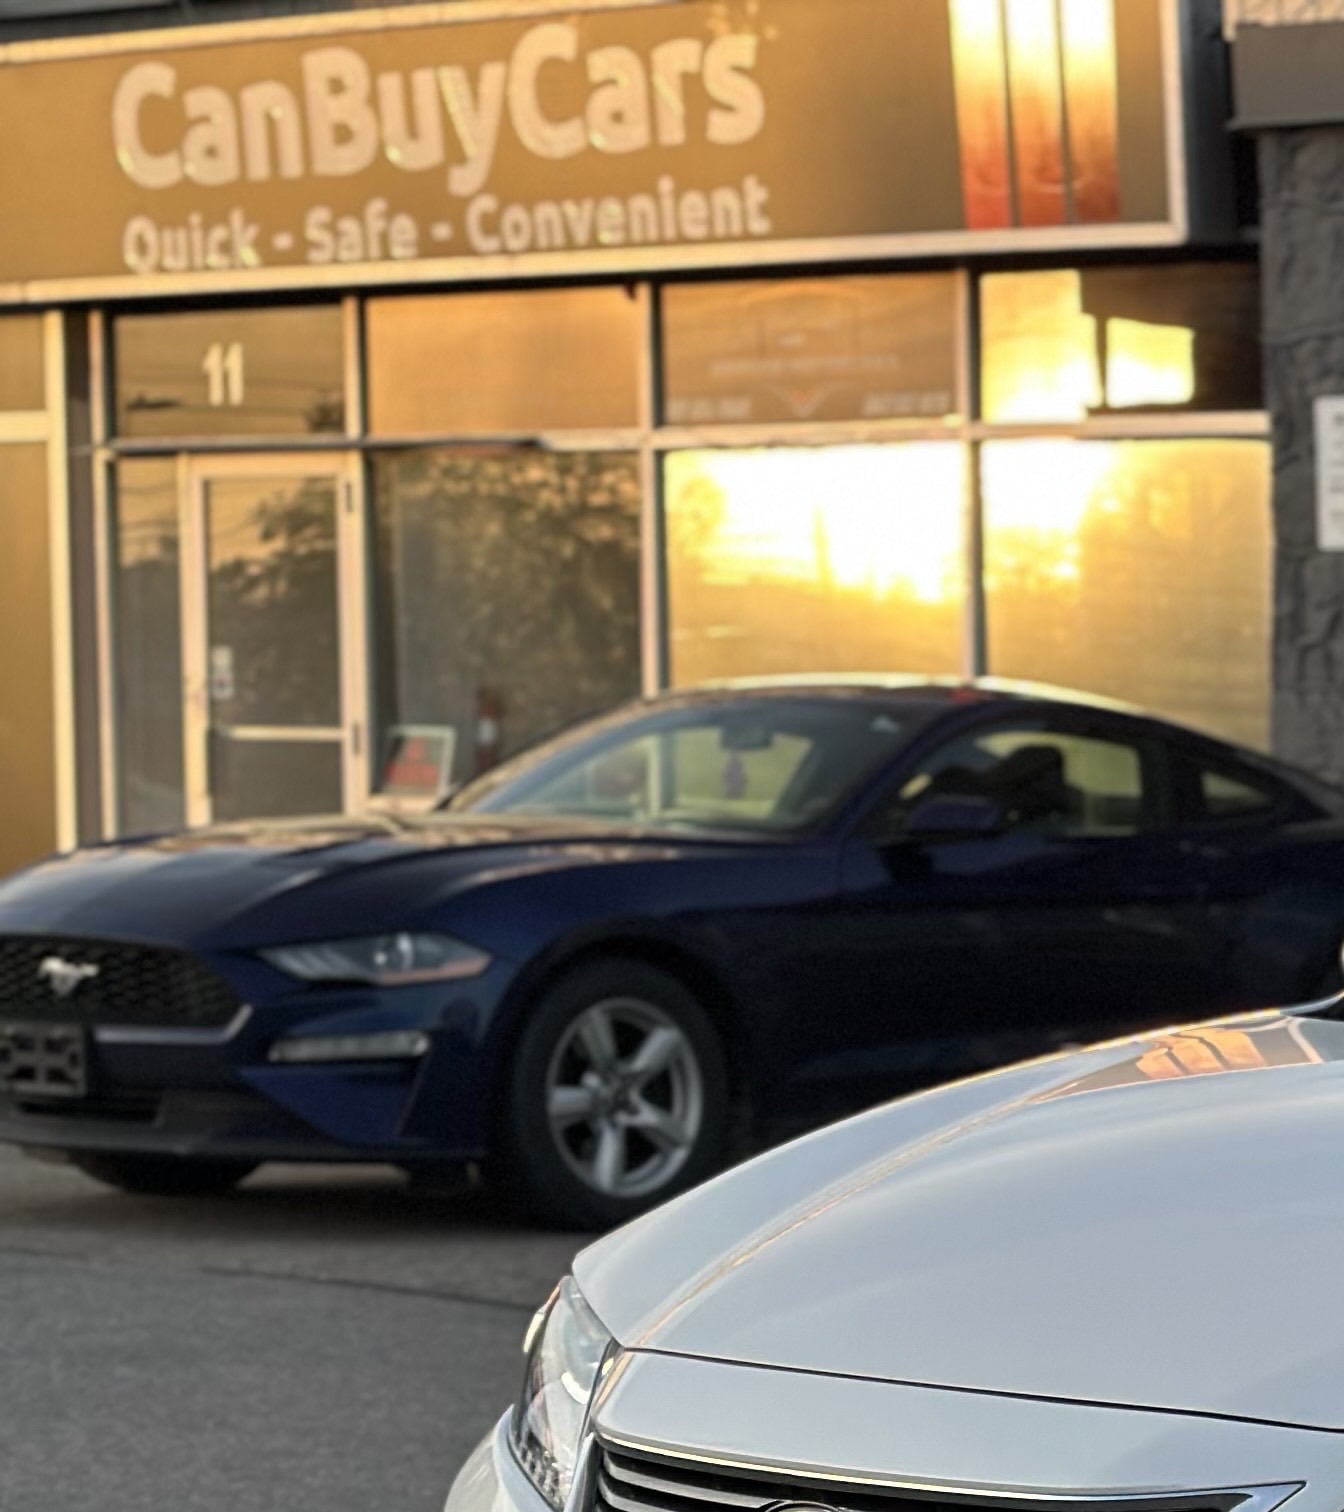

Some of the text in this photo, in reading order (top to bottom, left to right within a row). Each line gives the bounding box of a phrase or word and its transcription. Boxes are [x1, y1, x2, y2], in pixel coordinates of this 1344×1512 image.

[113, 22, 766, 197] CanBuyCars
[123, 209, 261, 275] Quick
[304, 199, 419, 267] Safe
[465, 175, 772, 254] Convenient
[202, 342, 244, 407] 11
